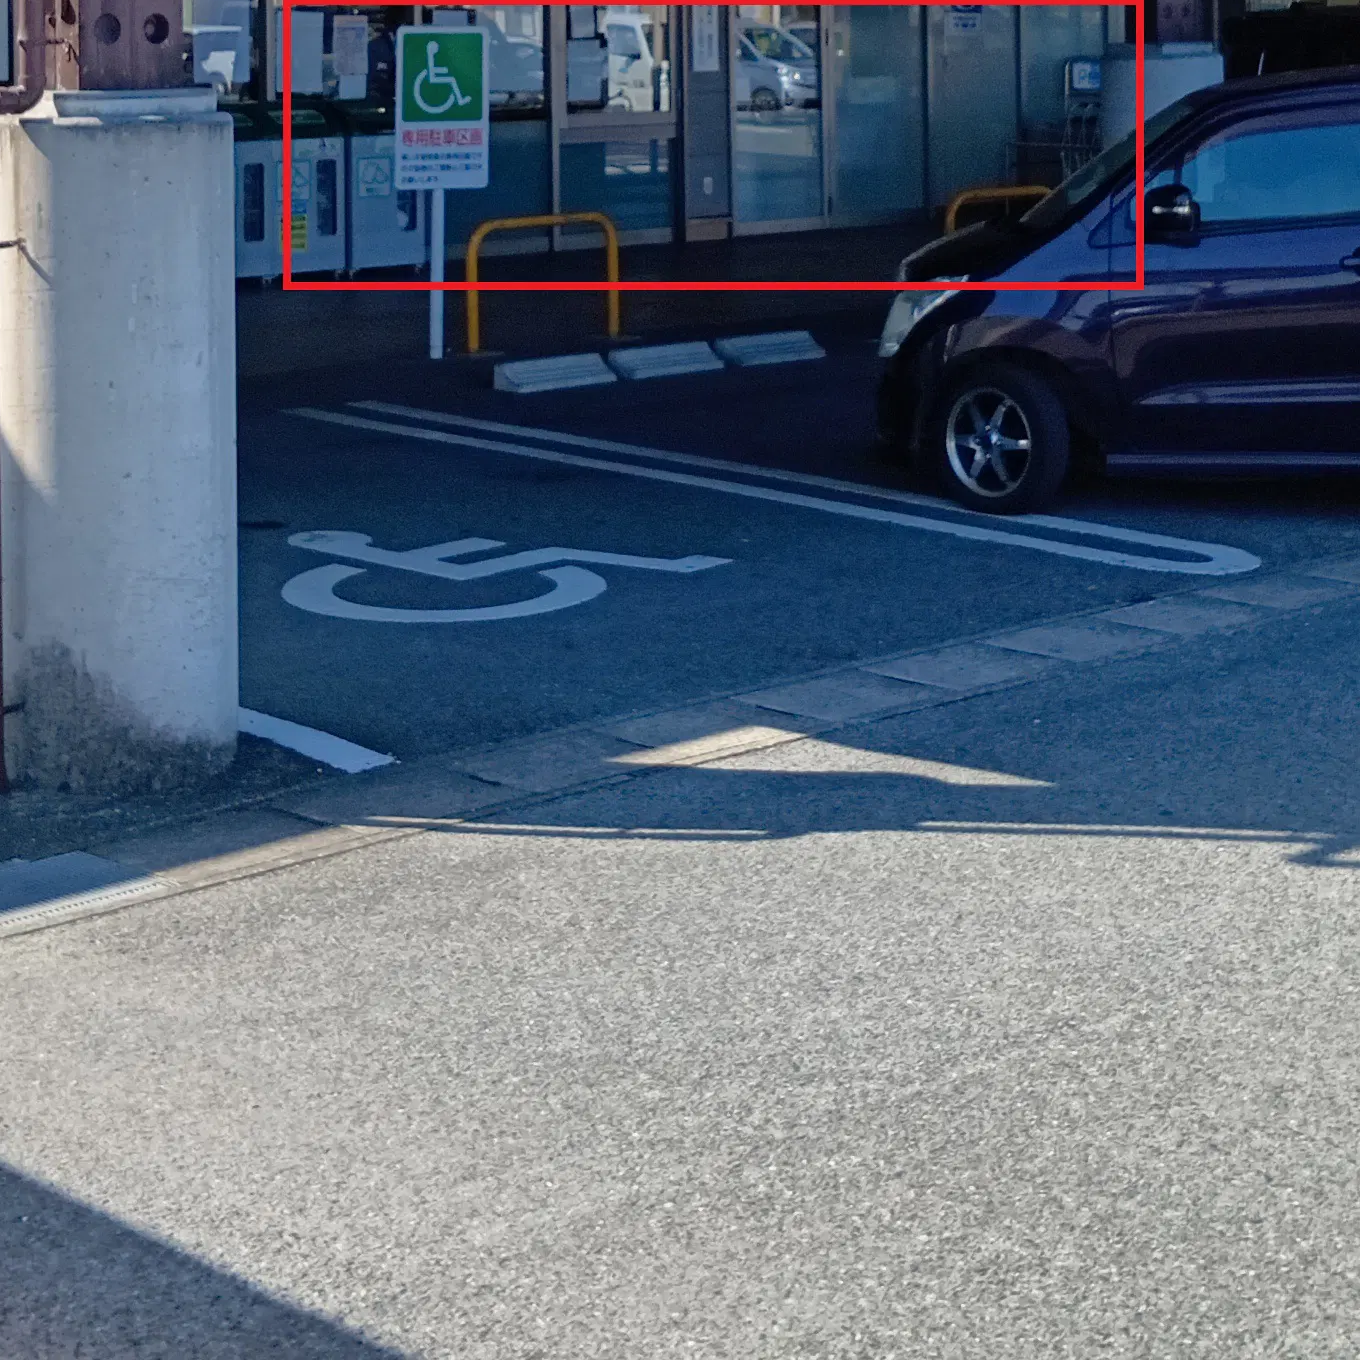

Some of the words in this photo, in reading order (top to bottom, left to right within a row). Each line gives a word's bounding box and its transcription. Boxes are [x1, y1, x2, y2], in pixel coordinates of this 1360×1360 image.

[401, 127, 483, 147] 専用駐車区画
